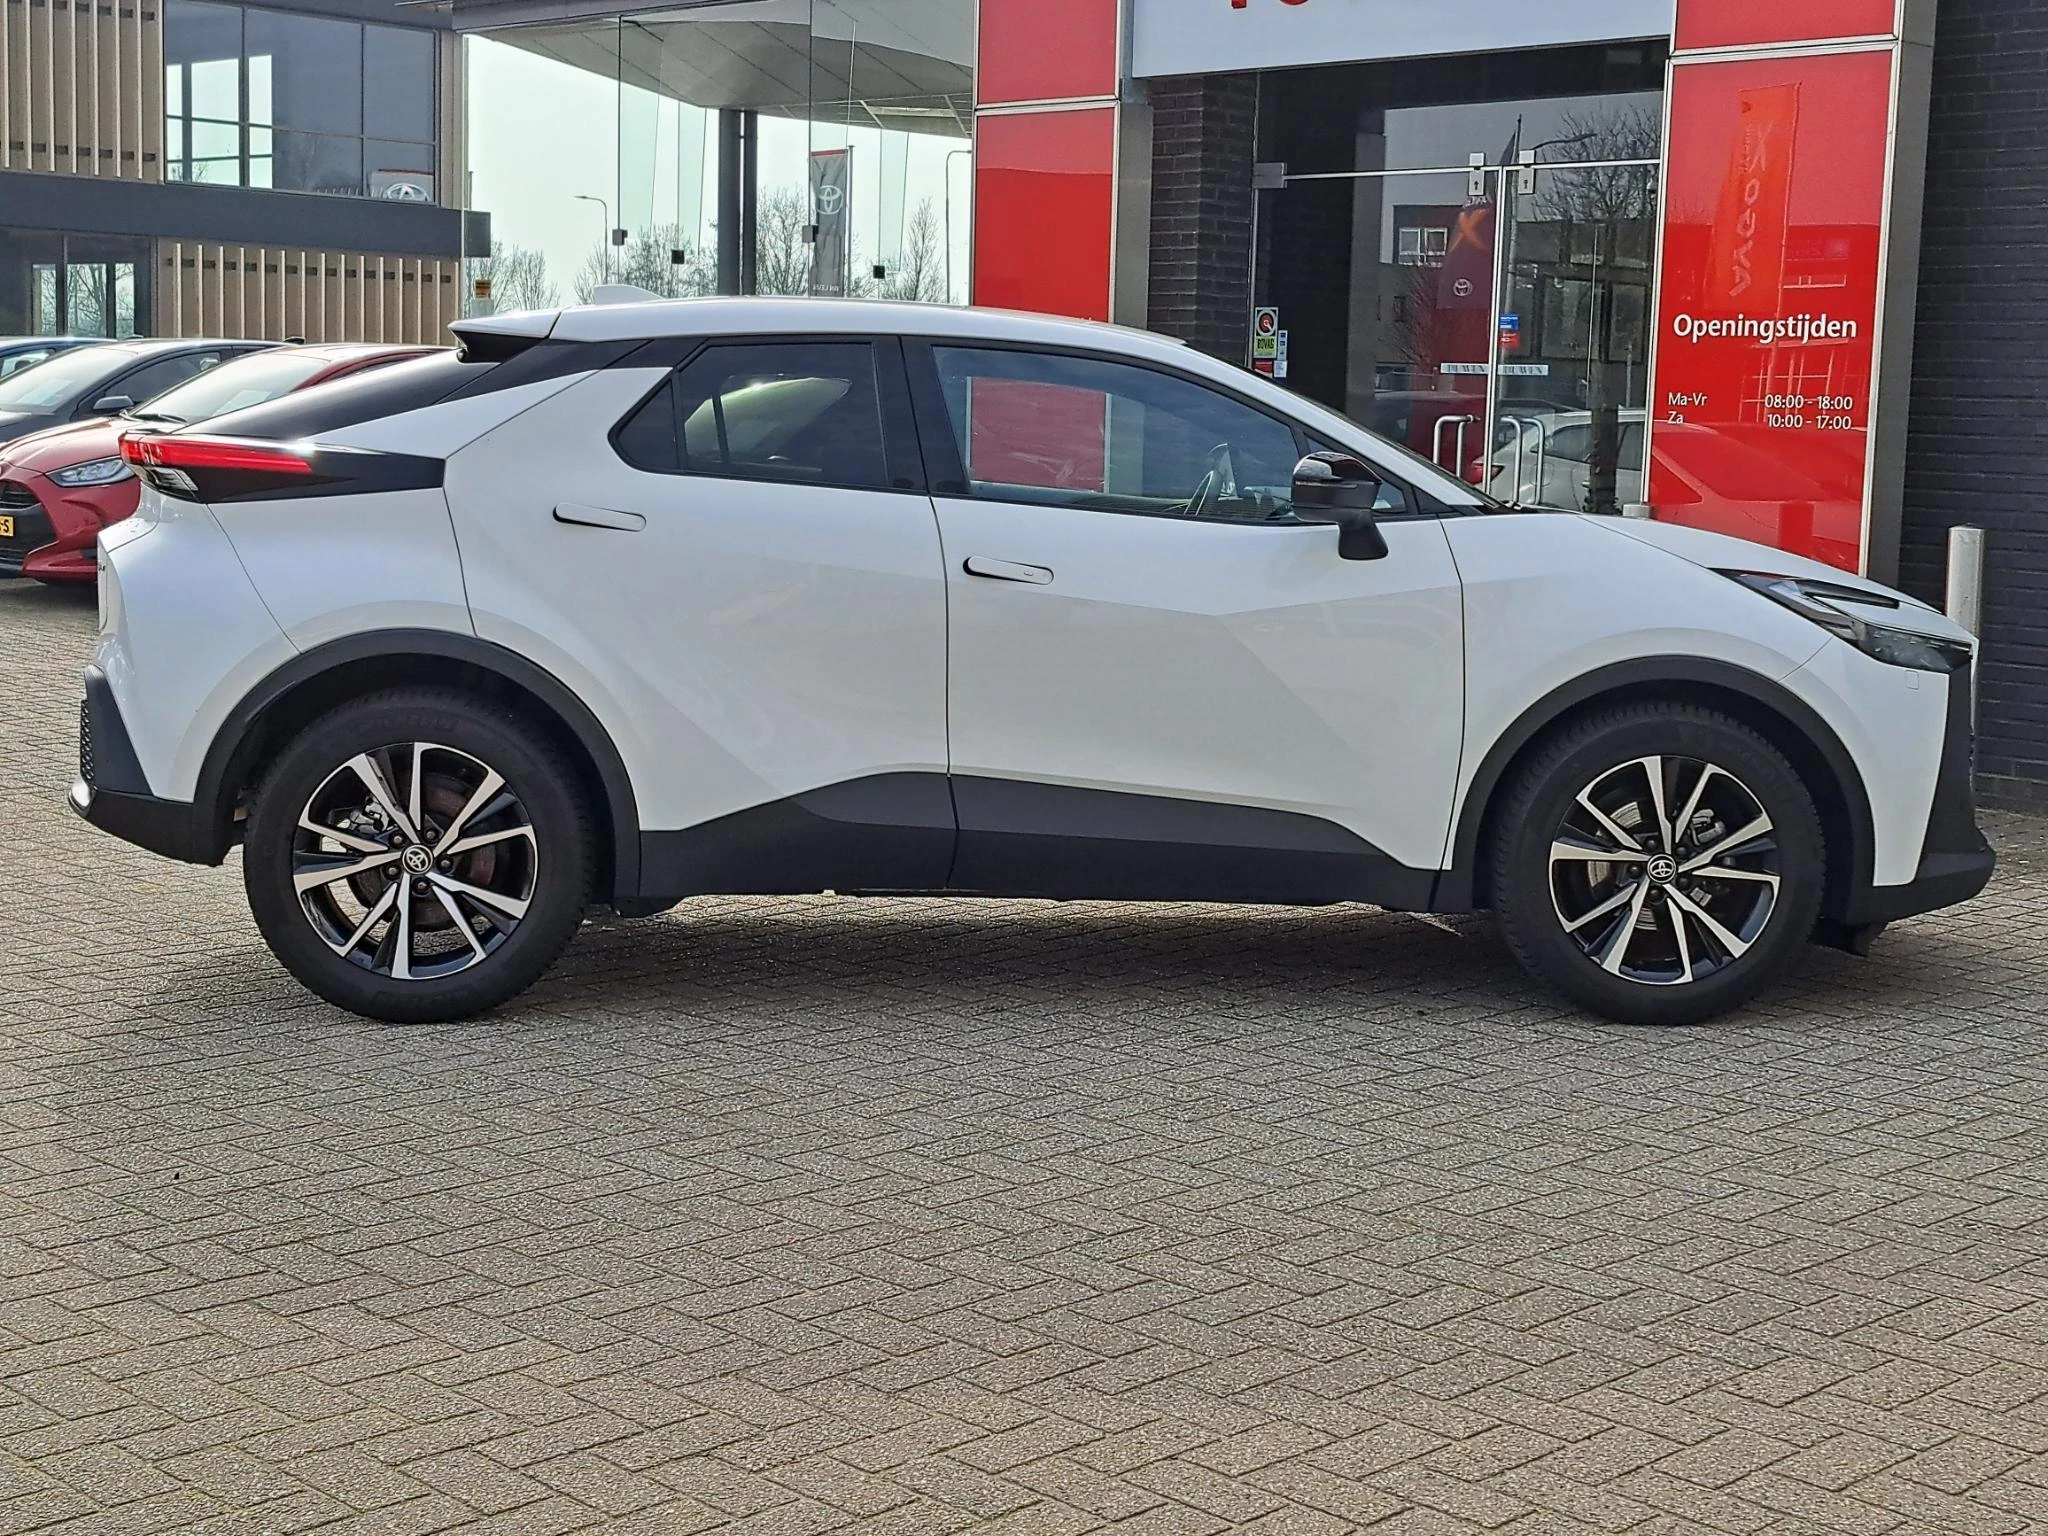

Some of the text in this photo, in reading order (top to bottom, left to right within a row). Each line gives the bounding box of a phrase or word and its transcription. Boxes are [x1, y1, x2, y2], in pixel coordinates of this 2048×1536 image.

[1673, 313, 1857, 344] Openingstijden
[1668, 392, 1707, 406] Ma-Vr
[1764, 394, 1804, 409] 08:00
[1816, 396, 1853, 410] 18:00
[1667, 411, 1684, 424] Za
[1767, 414, 1803, 428] 10:00
[1815, 416, 1852, 430] 17:00
